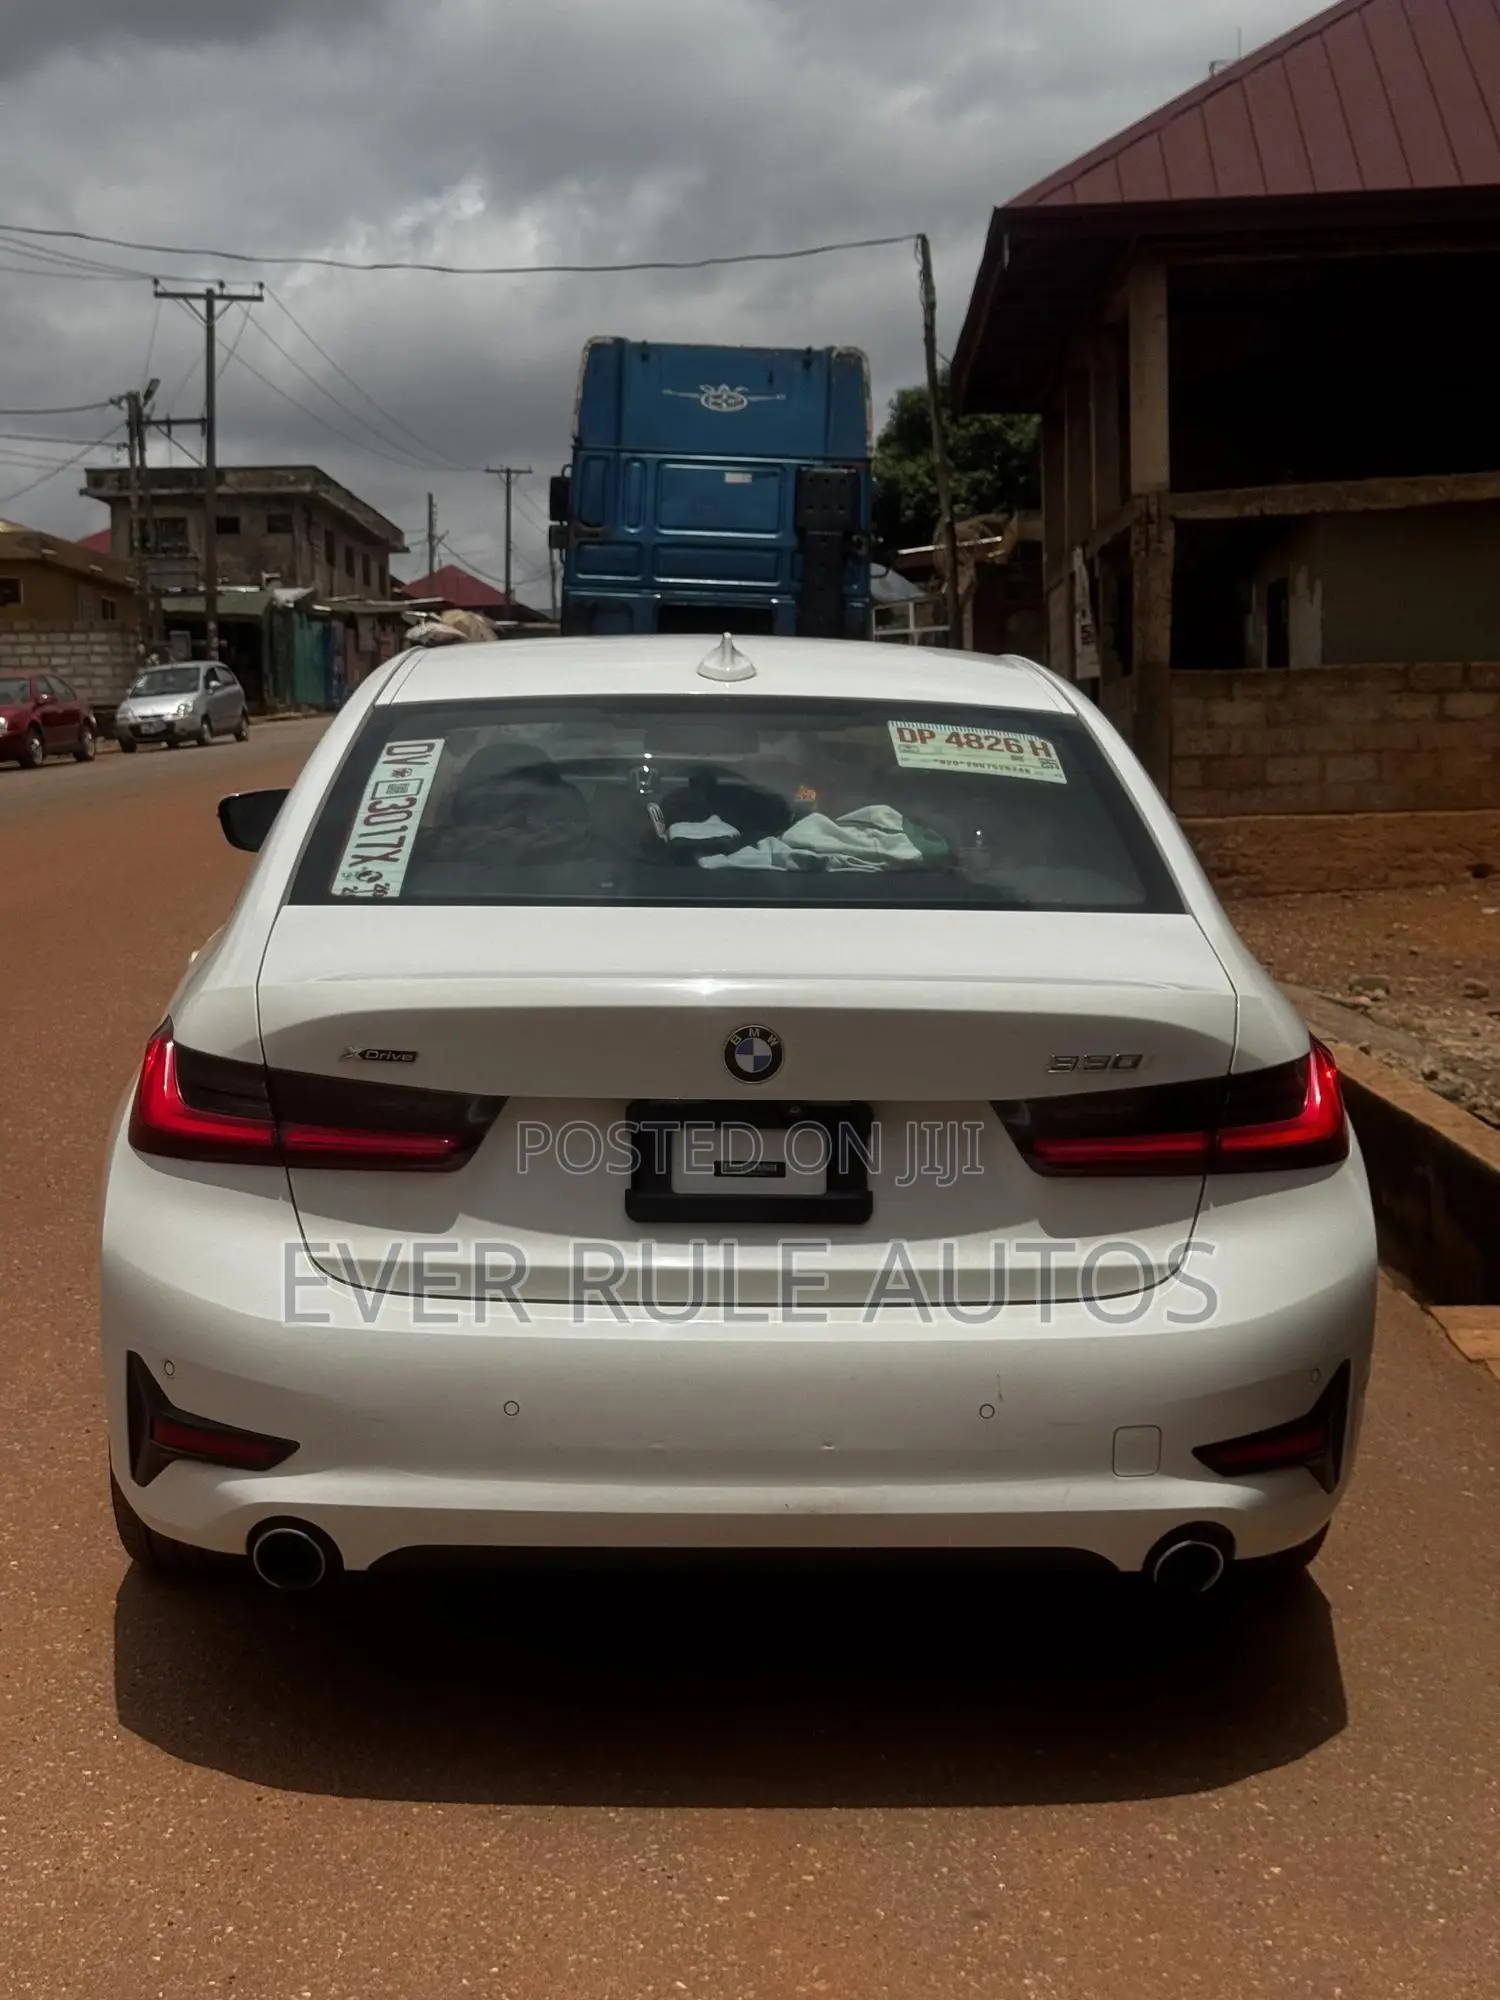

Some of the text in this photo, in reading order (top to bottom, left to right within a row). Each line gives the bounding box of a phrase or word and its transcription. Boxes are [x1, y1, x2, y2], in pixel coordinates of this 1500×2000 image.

[382, 742, 436, 766] DV
[897, 727, 1053, 758] DP 4826 H
